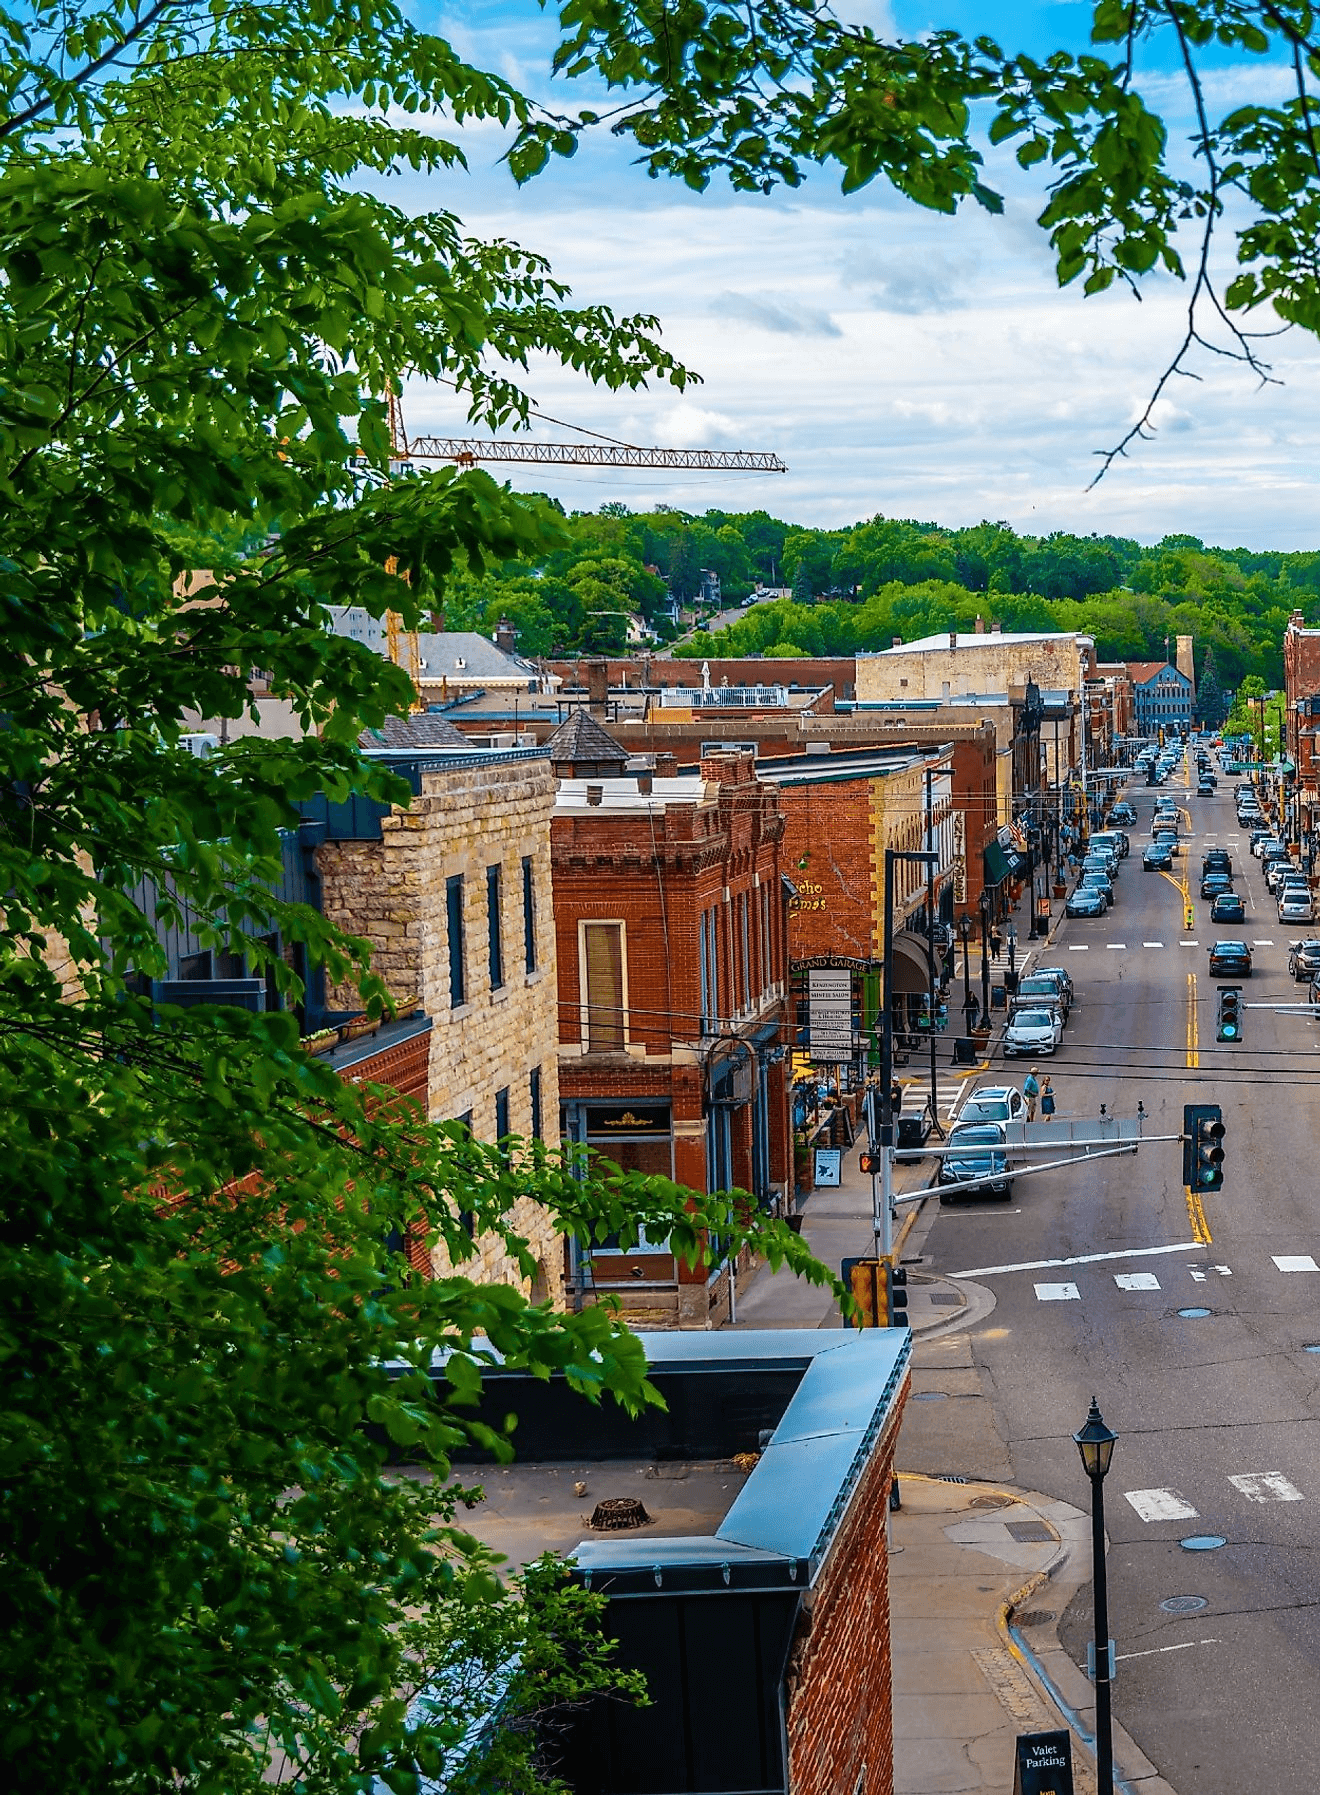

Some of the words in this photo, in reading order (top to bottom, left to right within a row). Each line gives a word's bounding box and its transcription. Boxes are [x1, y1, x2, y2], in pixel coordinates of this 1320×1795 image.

[797, 880, 823, 895] cho
[791, 958, 827, 972] GRAND
[829, 957, 868, 972] GARAGE
[1032, 1744, 1058, 1756] Valet
[1026, 1756, 1066, 1769] Parking
